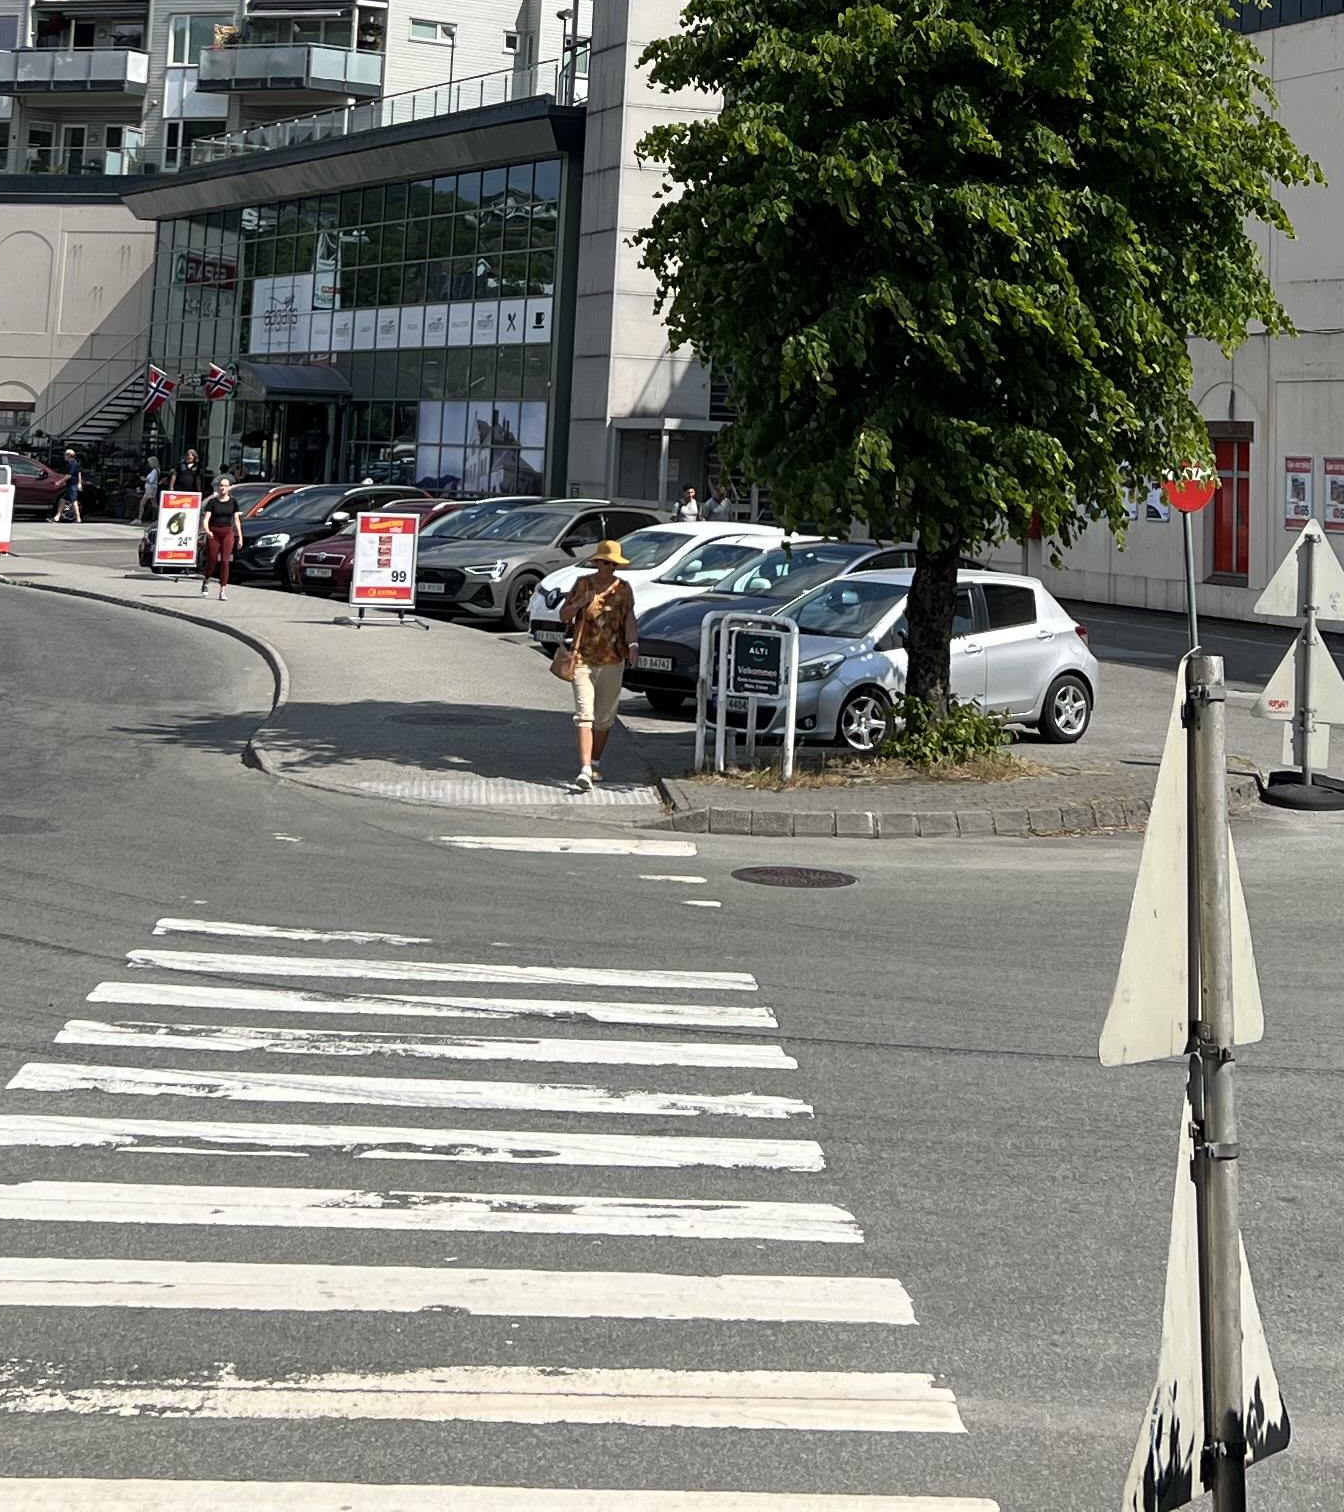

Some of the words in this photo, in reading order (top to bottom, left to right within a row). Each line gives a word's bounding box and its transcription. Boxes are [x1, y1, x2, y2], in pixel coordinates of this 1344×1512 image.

[391, 570, 407, 582] 99
[749, 647, 768, 655] ALTI
[737, 666, 777, 677] Velkommen
